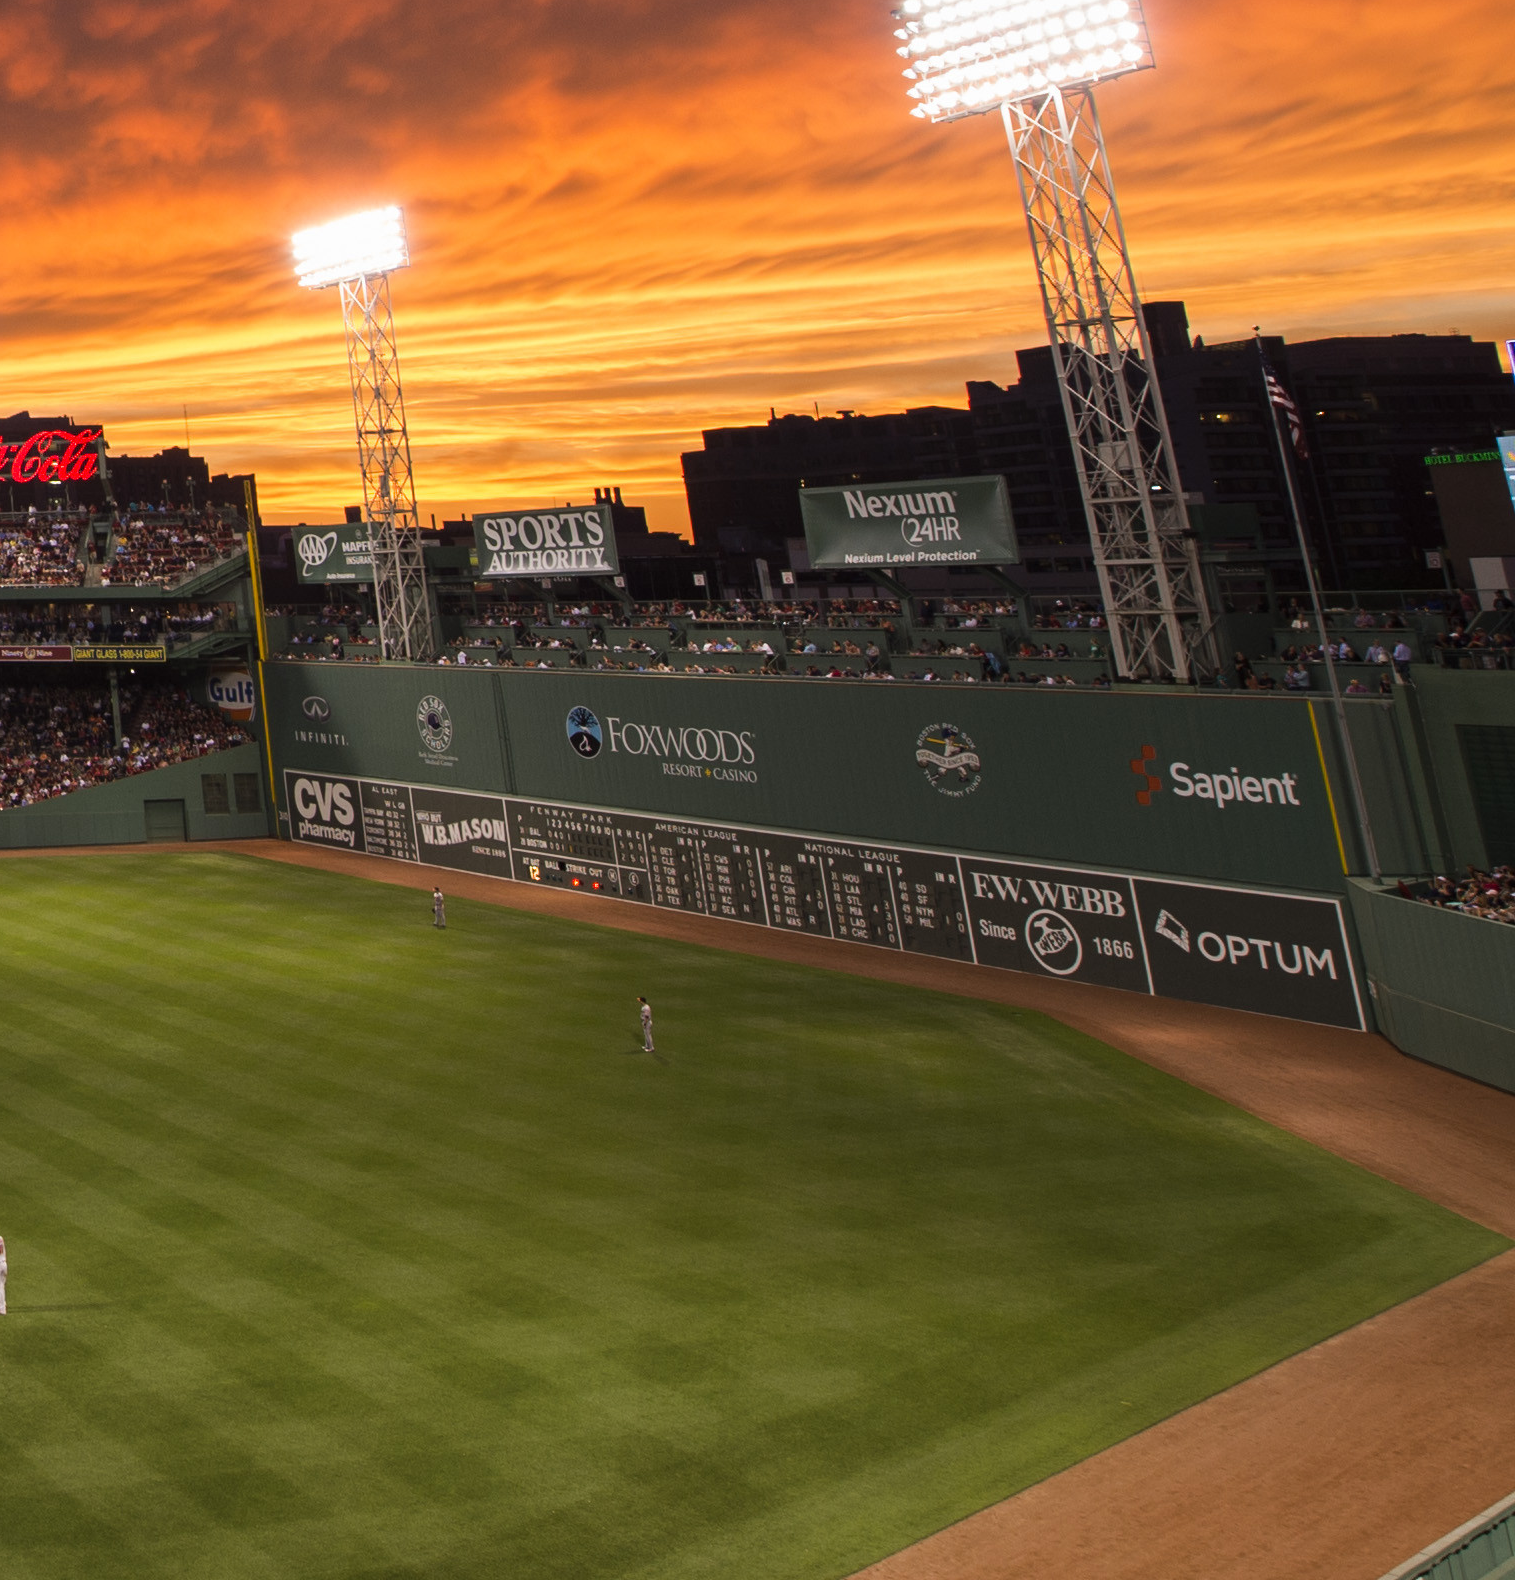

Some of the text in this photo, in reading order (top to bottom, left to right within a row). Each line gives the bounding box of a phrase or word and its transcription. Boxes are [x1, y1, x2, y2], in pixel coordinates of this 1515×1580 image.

[1424, 455, 1452, 465] HOTEL
[842, 490, 957, 518] Nexium
[483, 511, 604, 551] SPORTS
[845, 550, 977, 564] Nexium Level Protection
[1, 649, 53, 658] Ninety Nine
[76, 649, 117, 658] GIANT GLASS
[210, 678, 252, 703] Gulf
[429, 698, 444, 714] SOX
[606, 717, 755, 764] FOXWOODS
[917, 723, 940, 746] BOSTON
[663, 763, 757, 783] RESORT CASINO
[924, 769, 937, 787] THE
[965, 774, 982, 794] FUND
[382, 787, 398, 796] EAST
[1169, 762, 1300, 808] Sapient
[294, 778, 355, 826] CVS
[530, 806, 612, 824] FENWAY PARK
[299, 819, 355, 847] pharmacy
[655, 823, 738, 841] AMERICAN LEAGUE
[472, 845, 490, 856] SINCE
[804, 843, 901, 863] NATIONAL LEAGUE
[589, 868, 603, 878] OUT
[779, 874, 795, 885] COL
[847, 896, 863, 907] STL
[1027, 879, 1126, 917] WEBB
[722, 905, 736, 915] SEA
[850, 917, 866, 928] LAD
[979, 919, 1017, 941] Since
[1093, 937, 1134, 960] 1866
[1197, 931, 1338, 980] OPTUM
